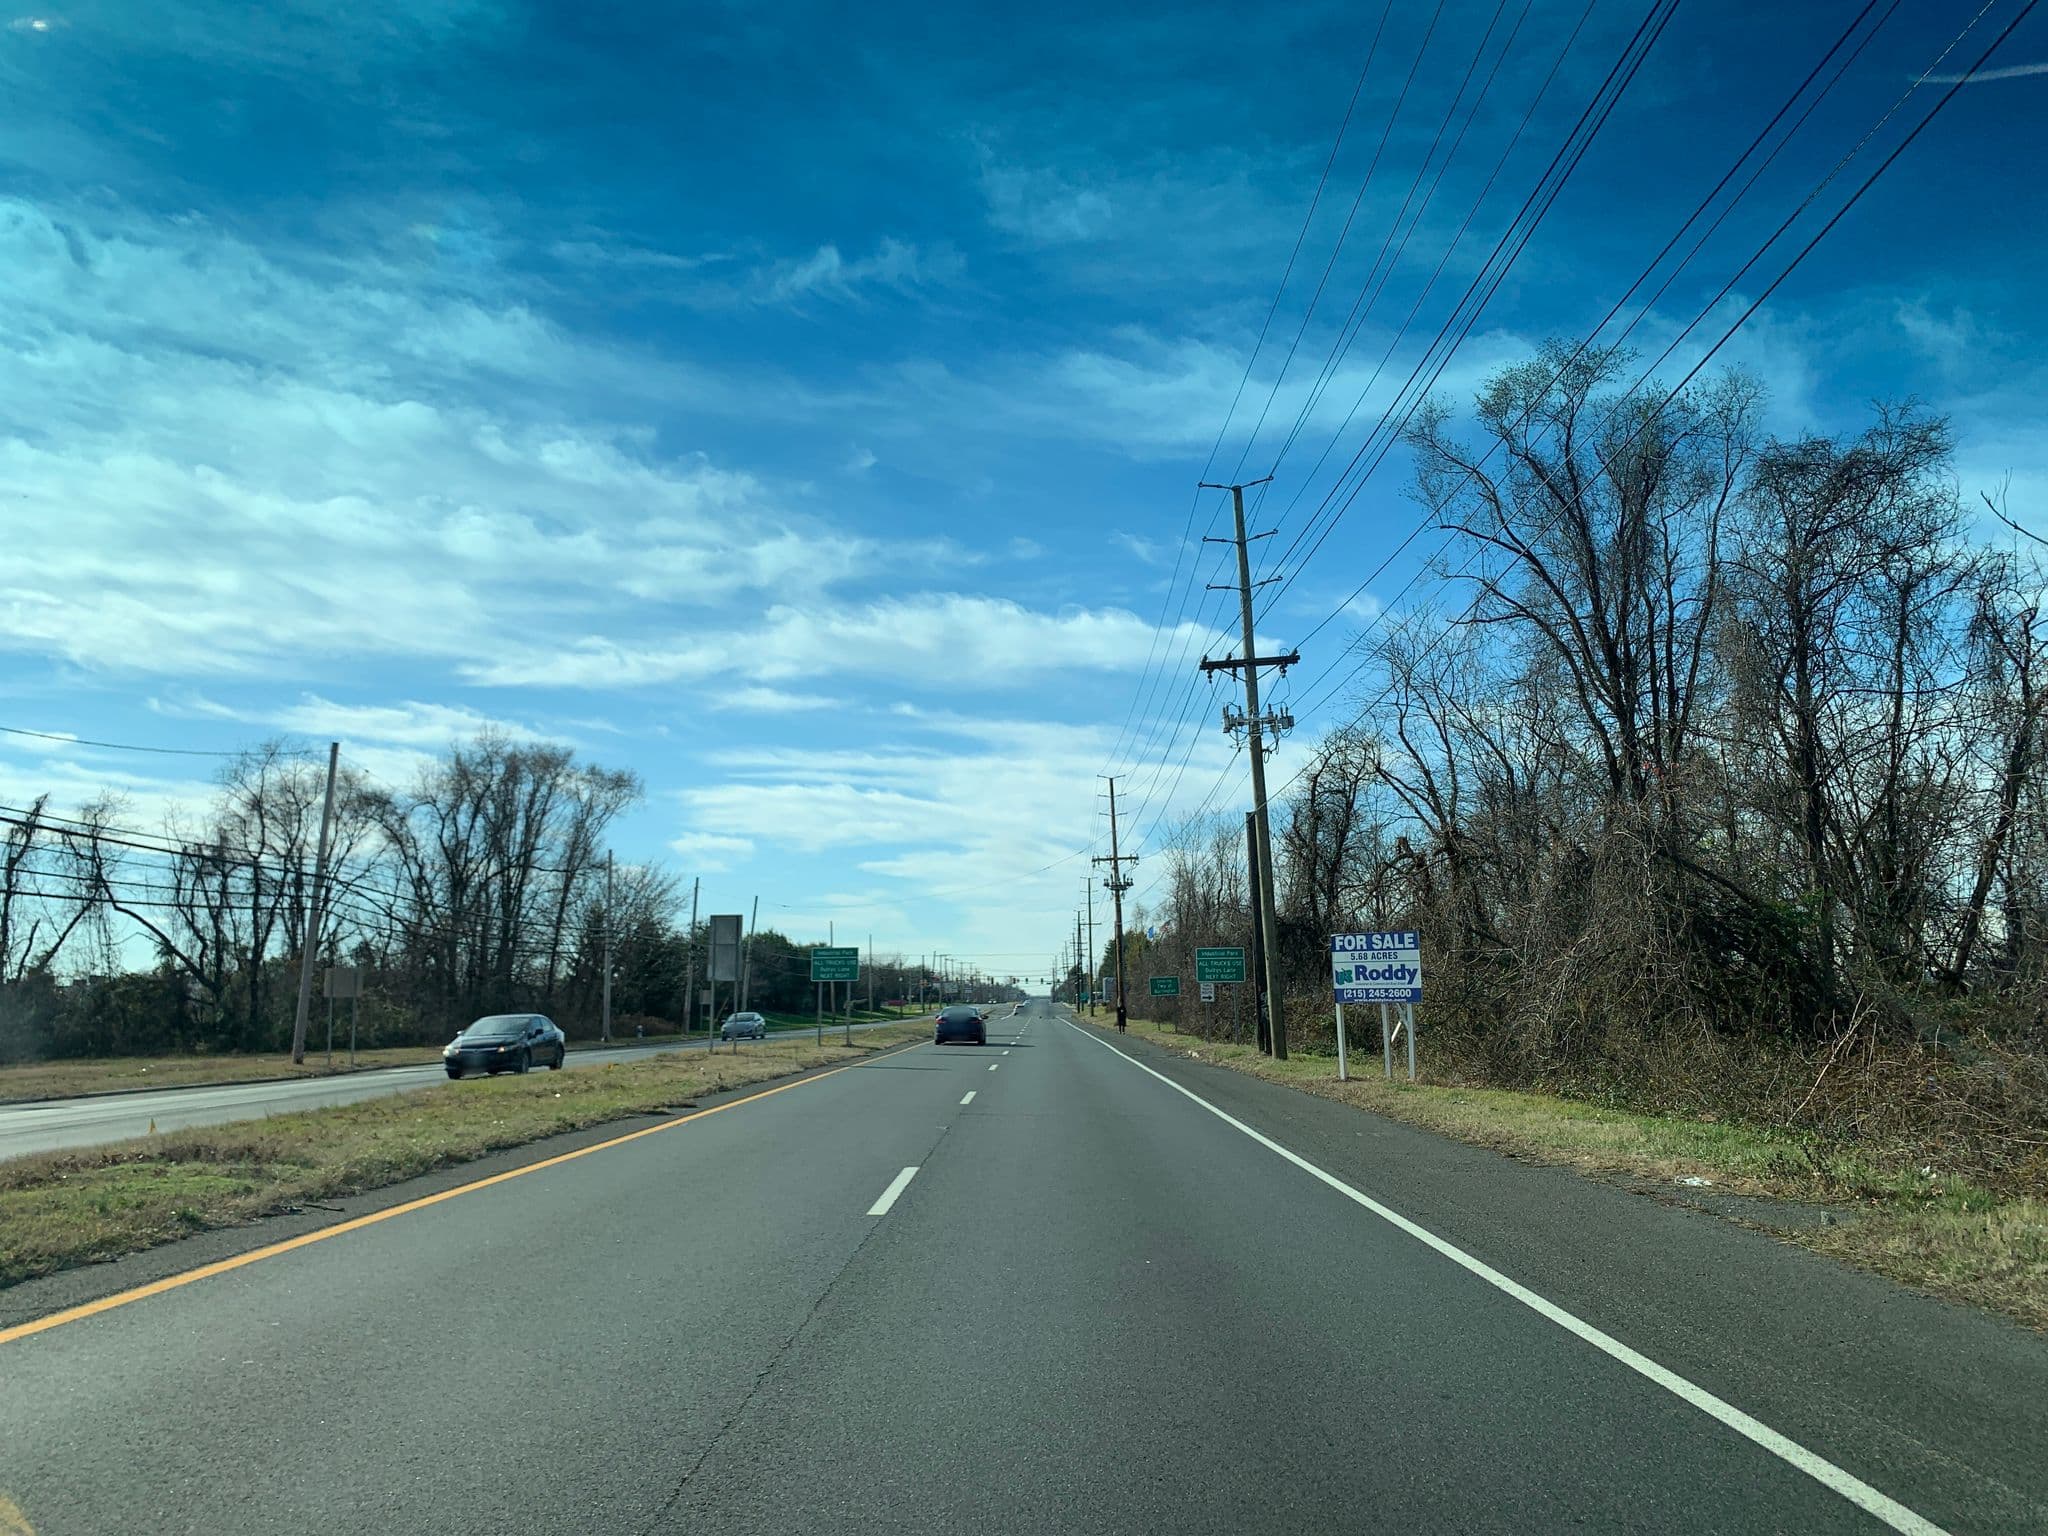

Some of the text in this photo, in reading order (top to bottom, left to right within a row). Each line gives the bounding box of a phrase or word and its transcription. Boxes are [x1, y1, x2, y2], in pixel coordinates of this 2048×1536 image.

[1335, 933, 1415, 950] FOR SALE
[1371, 951, 1399, 960] ACRES
[1354, 964, 1418, 985] Roddy
[1343, 989, 1412, 999] (215) 245-2600
